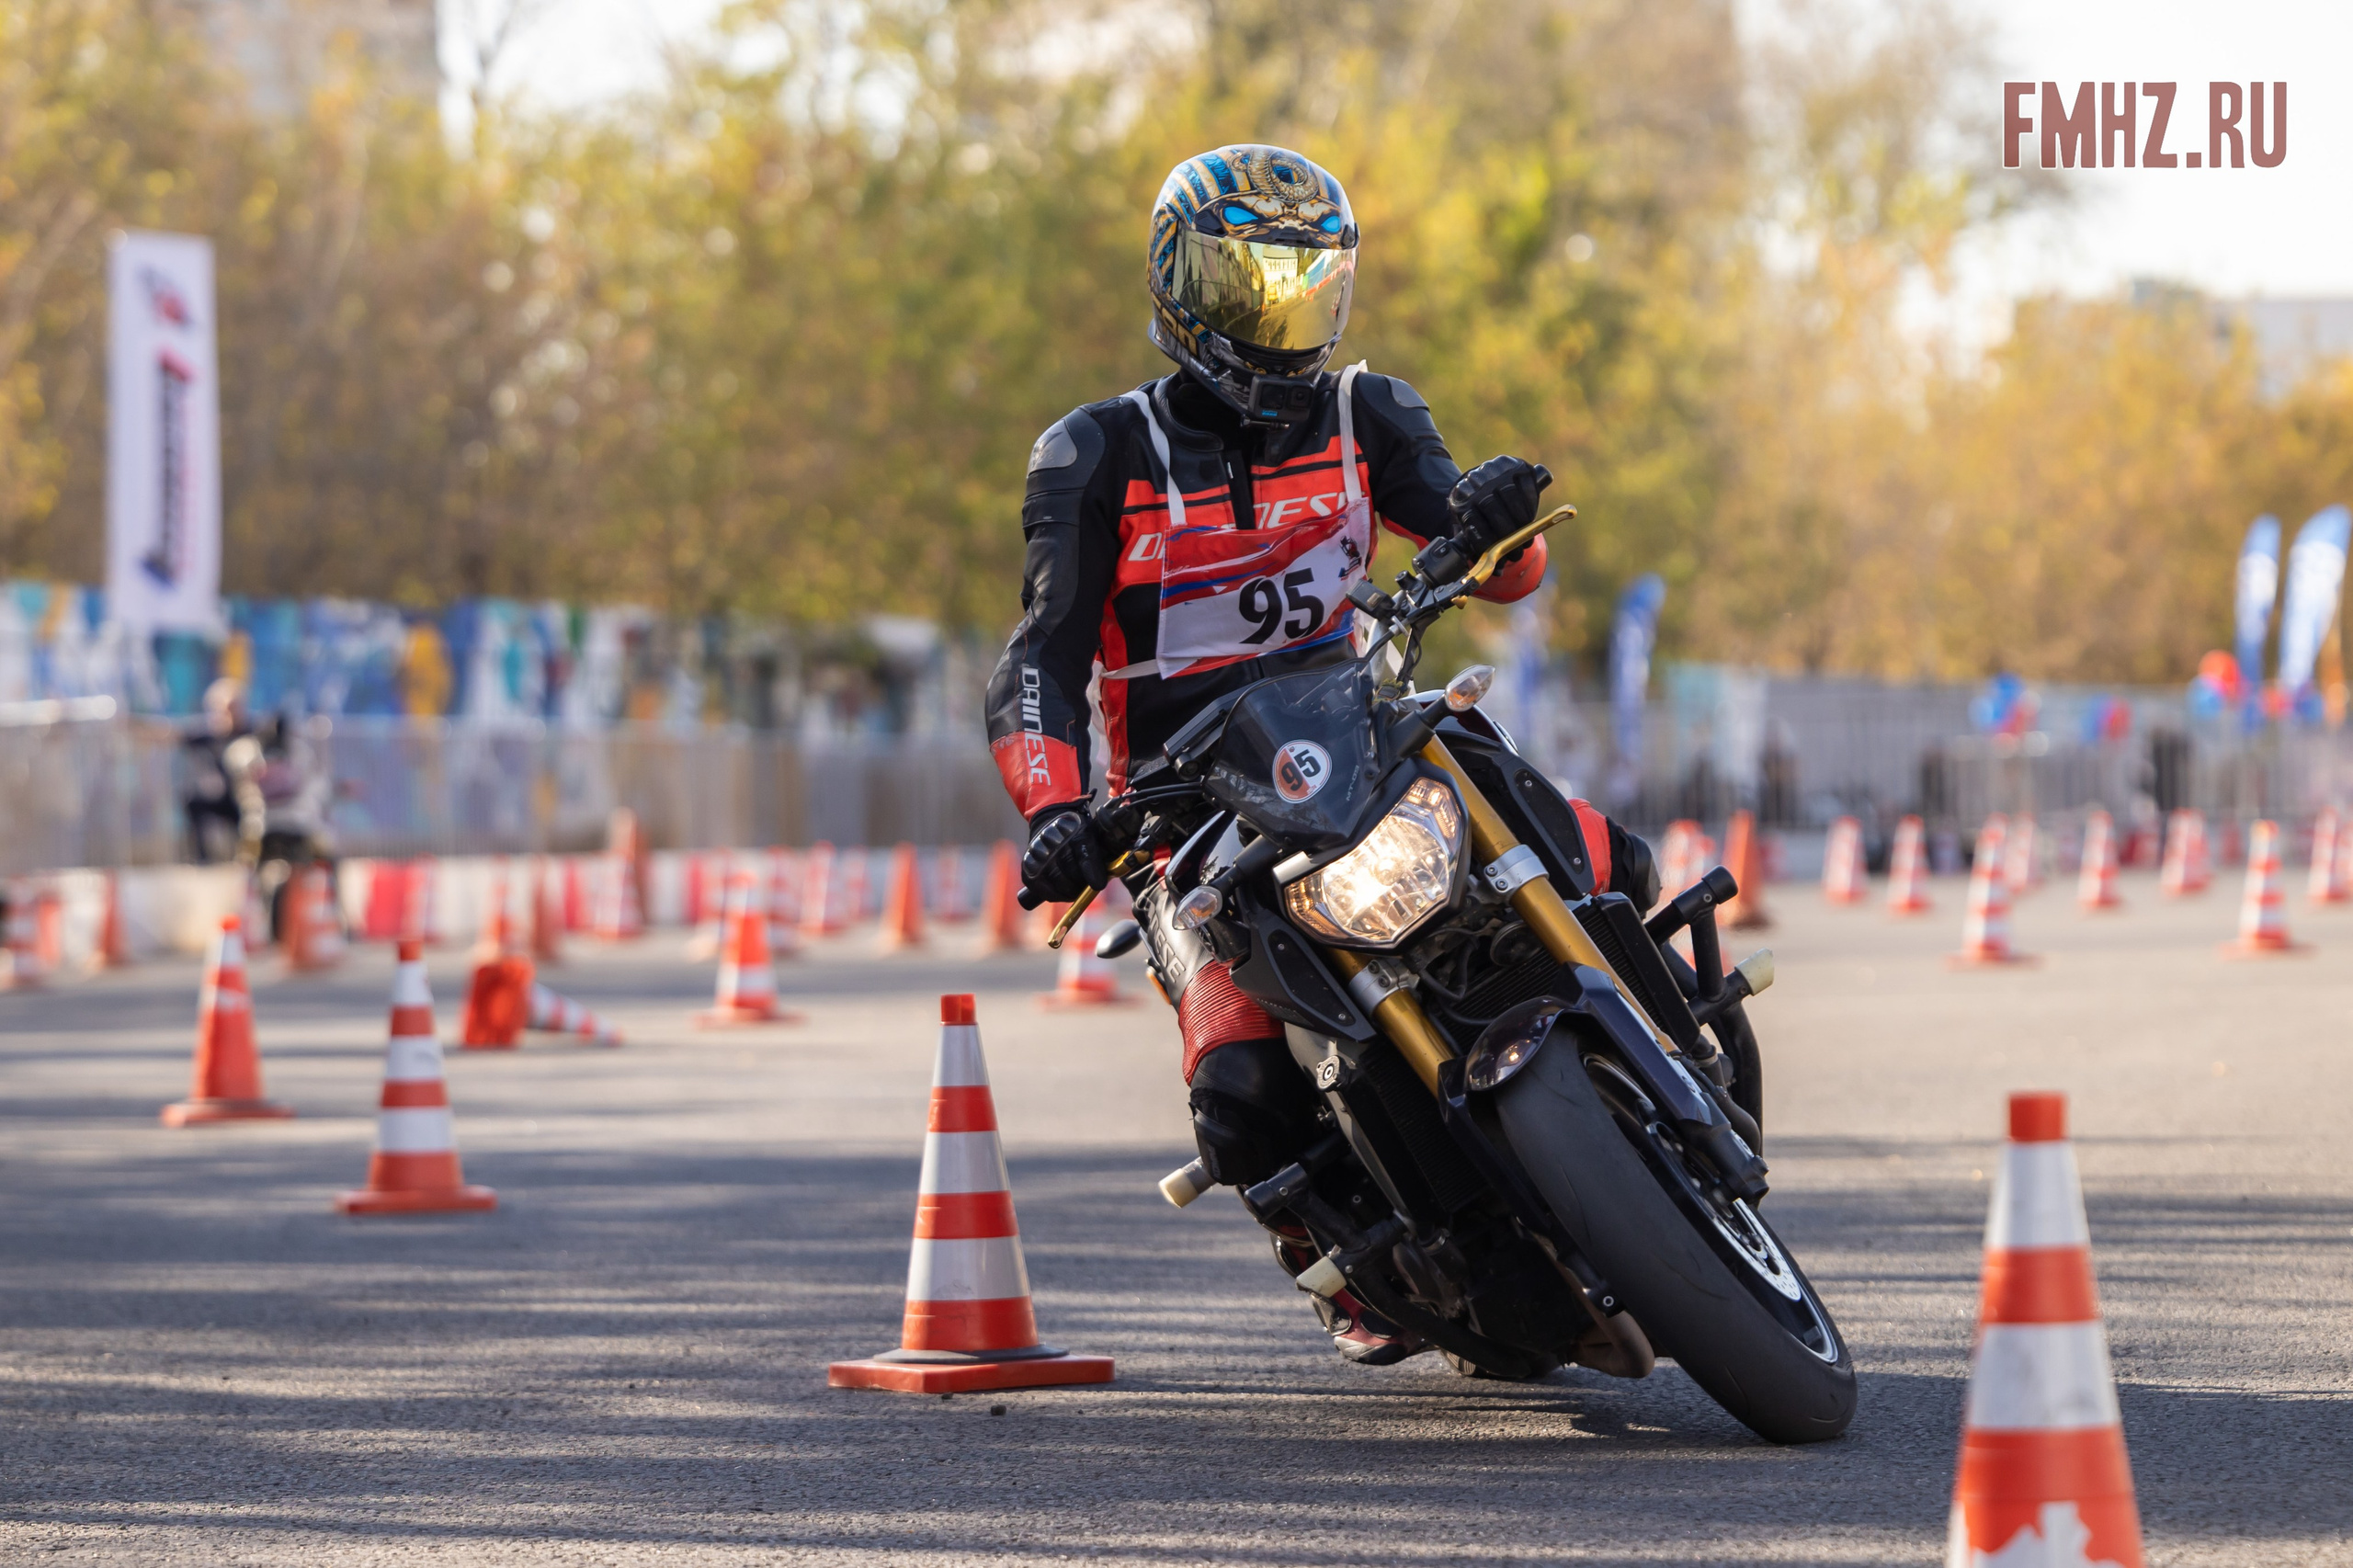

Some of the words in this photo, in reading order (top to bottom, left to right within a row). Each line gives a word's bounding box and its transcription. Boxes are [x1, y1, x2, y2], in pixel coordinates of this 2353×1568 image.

[1238, 566, 1324, 644] 95
[1022, 666, 1051, 786] DAINESE
[1281, 748, 1321, 791] 95
